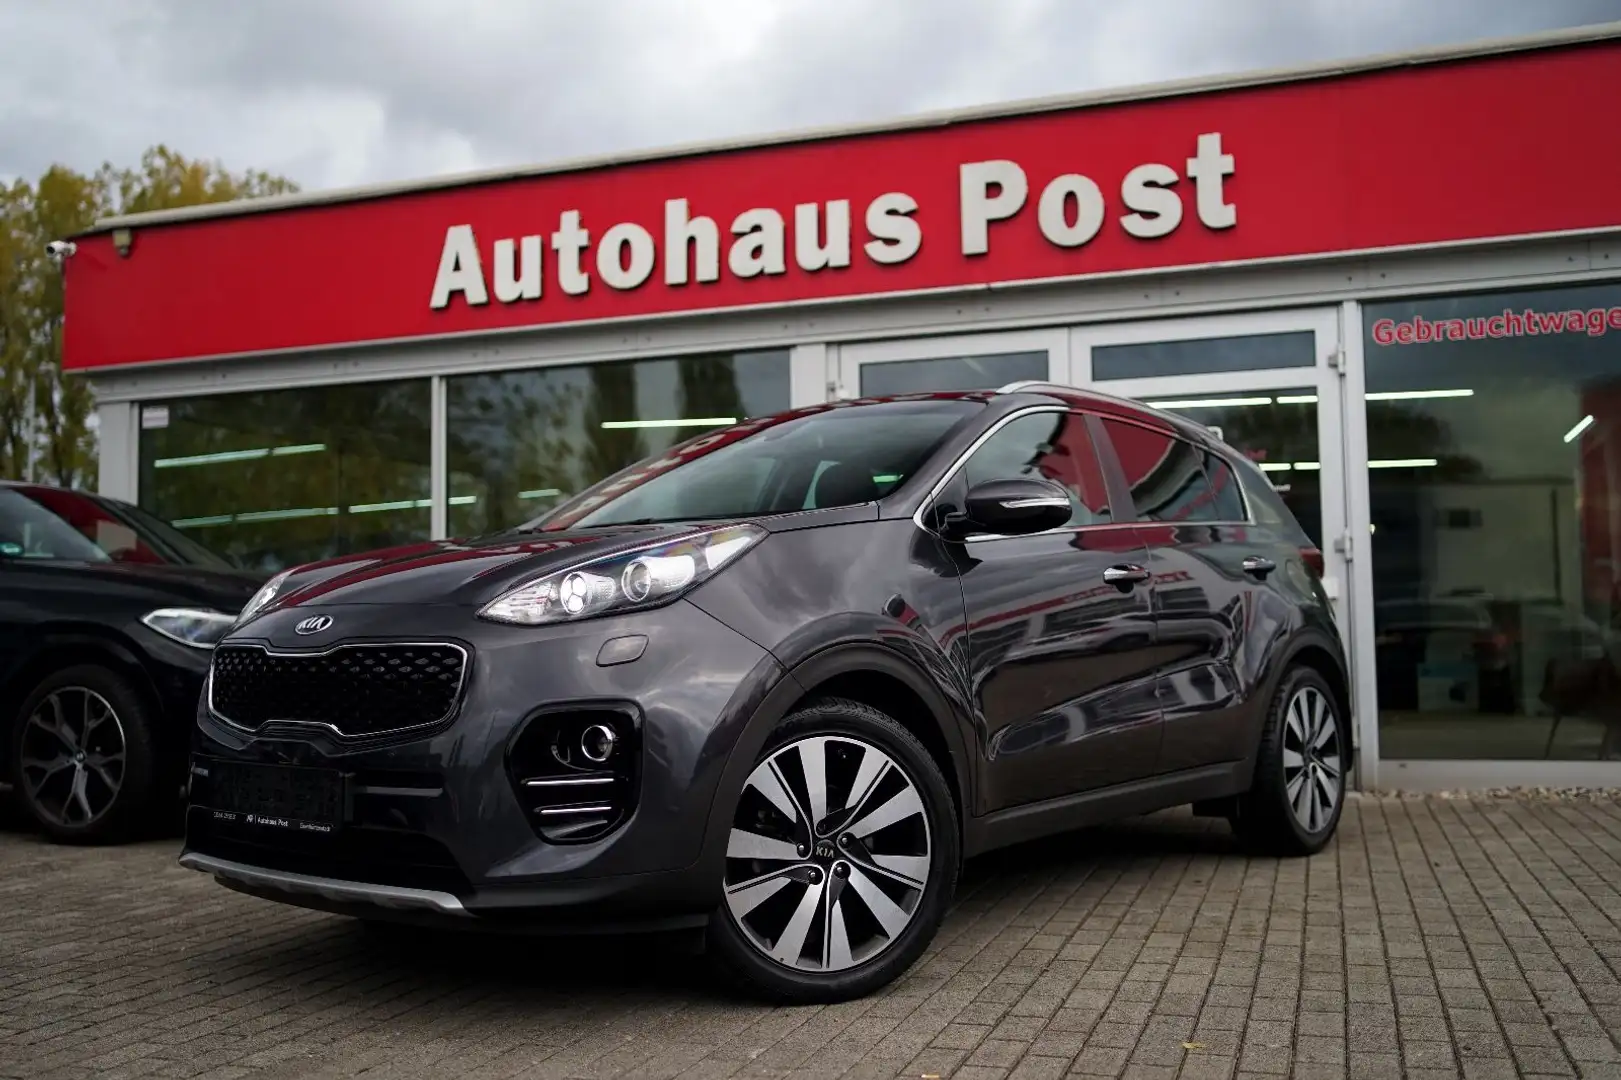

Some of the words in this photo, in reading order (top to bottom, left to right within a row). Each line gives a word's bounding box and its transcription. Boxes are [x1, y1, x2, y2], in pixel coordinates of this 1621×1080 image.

[430, 192, 922, 310] Autohaus
[960, 131, 1238, 257] Post
[815, 845, 834, 859] KIA
